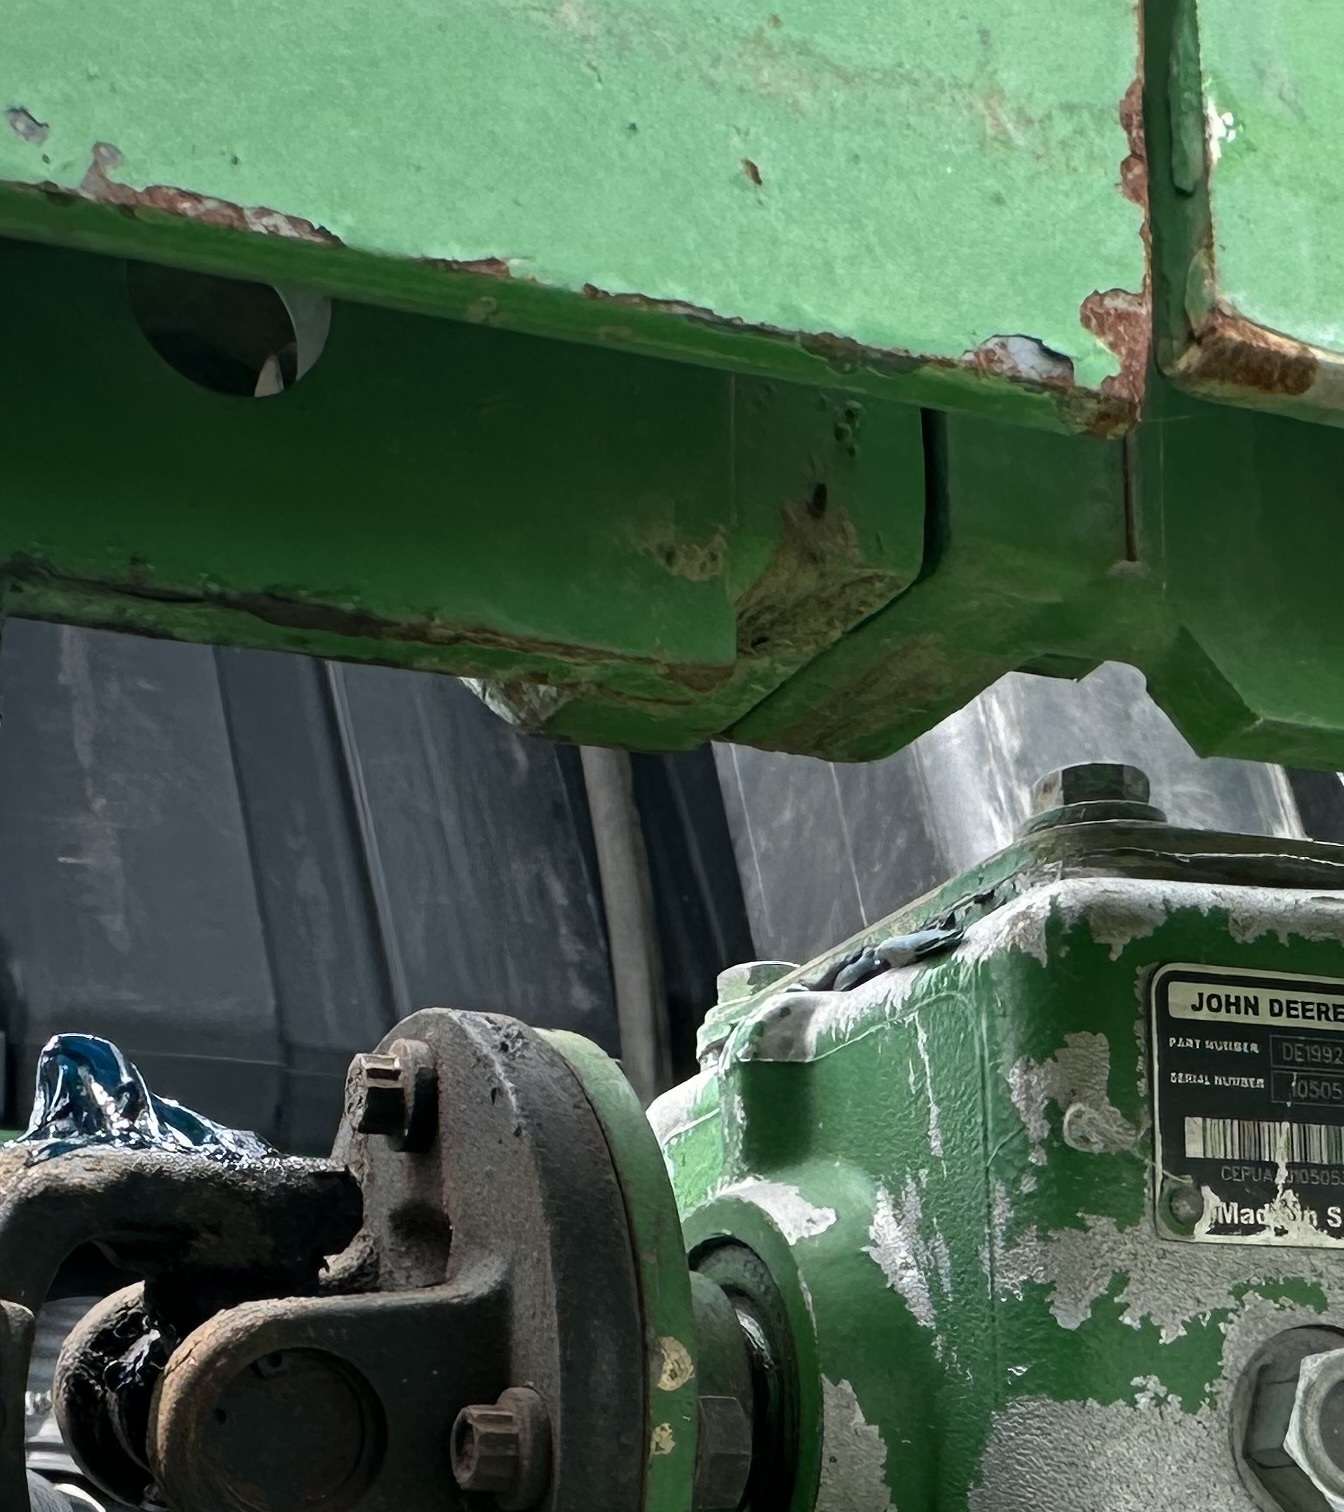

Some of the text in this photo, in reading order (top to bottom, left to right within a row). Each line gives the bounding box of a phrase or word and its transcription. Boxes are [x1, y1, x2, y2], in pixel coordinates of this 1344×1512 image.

[1191, 992, 1259, 1016] JOHN
[1169, 1037, 1200, 1049] PART
[1206, 1040, 1259, 1054] NUMBER
[1170, 1072, 1211, 1085] SERIAL
[1214, 1075, 1265, 1089] NUMBER
[1217, 1202, 1285, 1226] Mad
